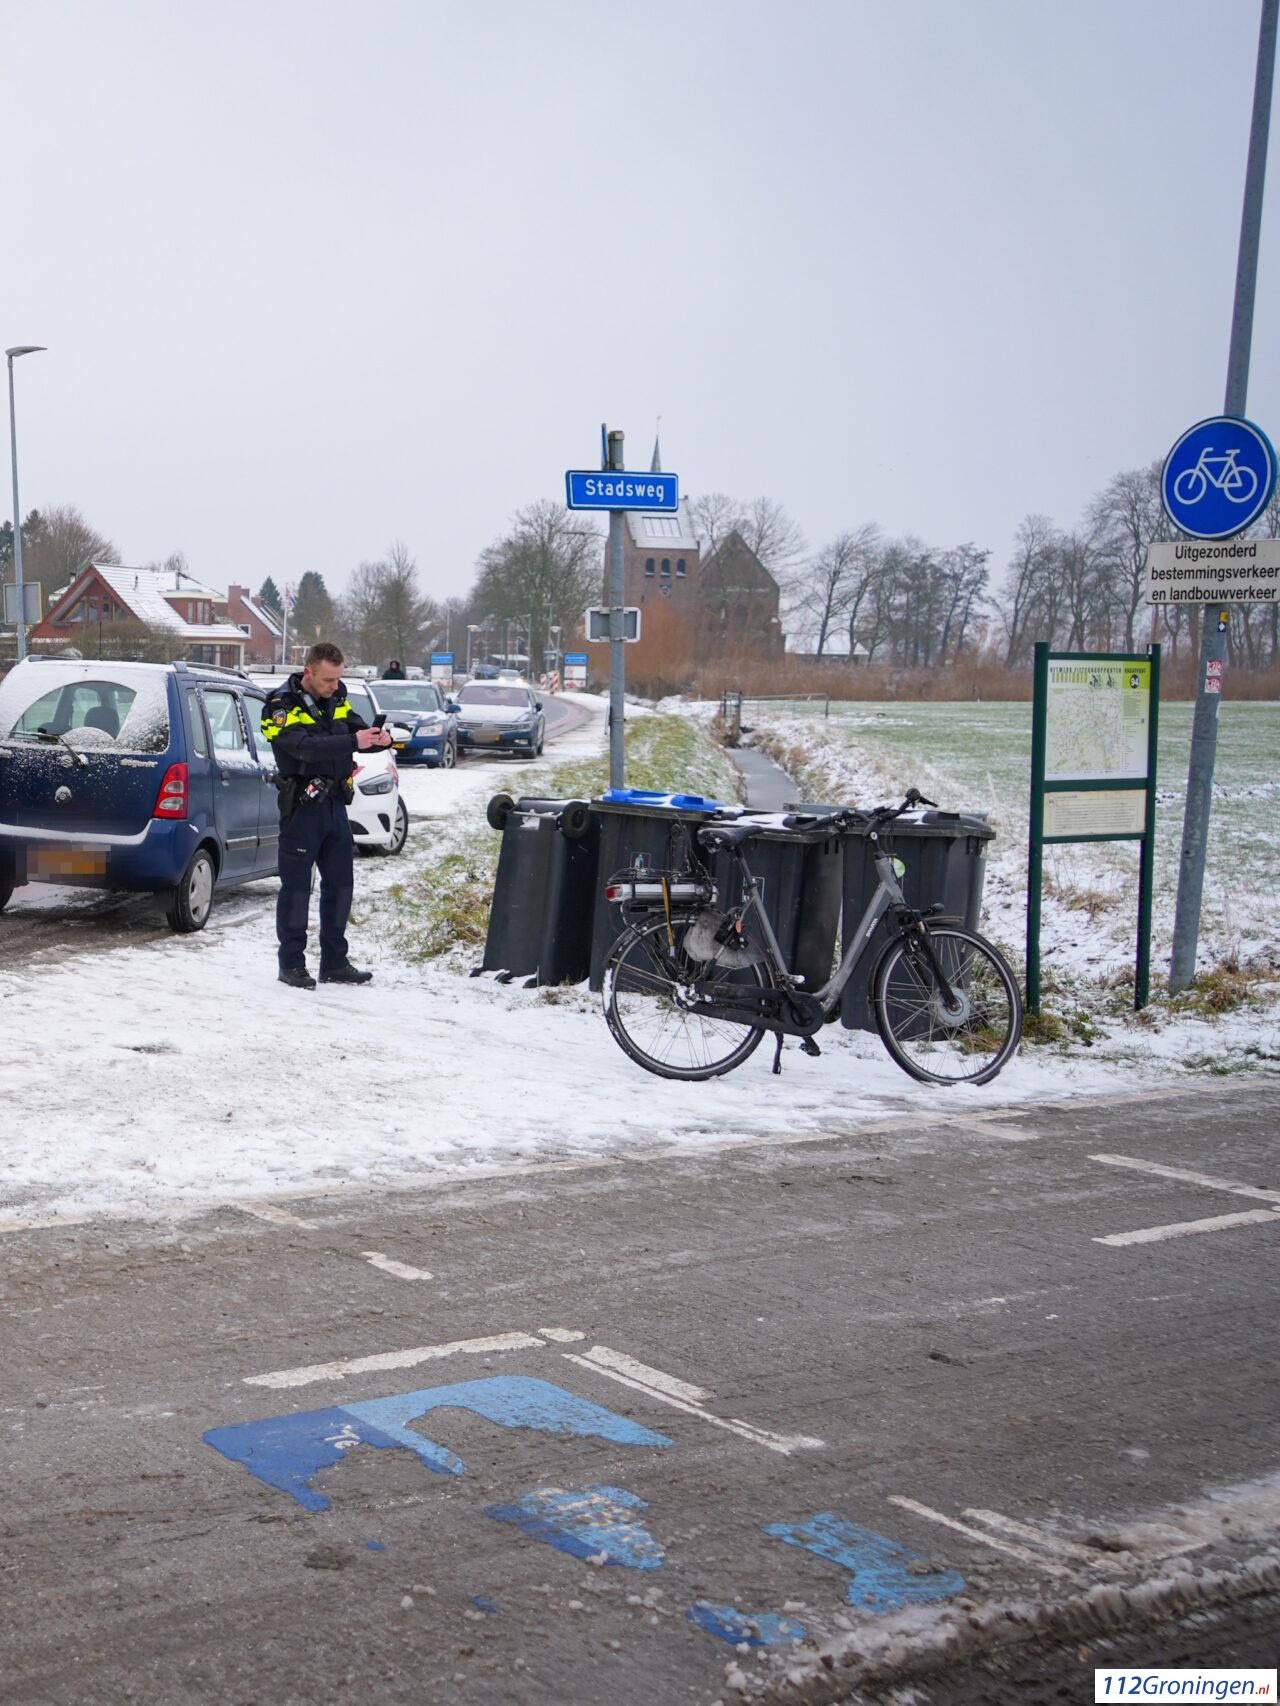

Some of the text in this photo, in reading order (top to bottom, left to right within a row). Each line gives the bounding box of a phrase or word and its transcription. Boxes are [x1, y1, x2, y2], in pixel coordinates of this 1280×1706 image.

[585, 479, 664, 502] Stadsweg
[1175, 543, 1257, 562] Uitgezonderd
[1151, 564, 1280, 582] bestemmingsverkeer
[1152, 585, 1277, 600] en landbouwverkeer
